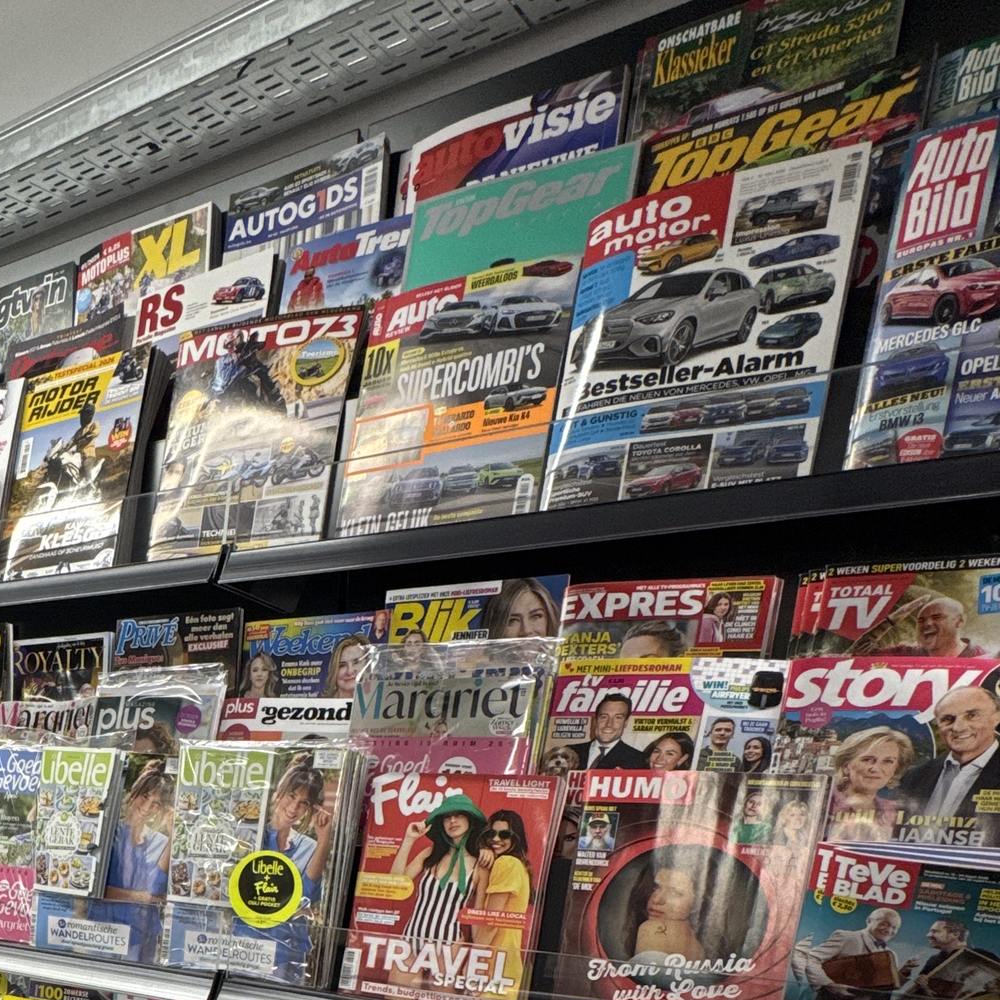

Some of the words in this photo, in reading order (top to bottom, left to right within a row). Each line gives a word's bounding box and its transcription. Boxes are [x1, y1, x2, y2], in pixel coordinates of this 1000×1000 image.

[658, 10, 741, 52] ONSCHATBARE
[780, 24, 841, 50] Strada
[653, 33, 738, 88] Klassieker
[647, 78, 919, 194] TopGear
[906, 129, 996, 192] Auto
[419, 163, 623, 241] TopGear
[902, 174, 983, 243] Bild
[589, 195, 693, 247] auto
[604, 211, 712, 256] motor
[81, 246, 131, 287] MOTOPLUS
[134, 218, 201, 289] XL
[470, 270, 518, 291] WEERGALOOS
[137, 283, 185, 339] RS
[878, 324, 948, 353] MERCEDES
[952, 318, 982, 336] GLC
[397, 342, 545, 400] SUPERCOMBI'S
[28, 376, 99, 410] MOTOR
[837, 565, 869, 575] WEKEN
[871, 559, 955, 573] SUPERVOORDELIG
[830, 586, 893, 597] TOTAAL
[391, 600, 484, 642] Blik
[828, 596, 890, 630] TV
[188, 640, 228, 651] EXCLUSIEF
[452, 629, 488, 642] JENNIFER
[280, 667, 321, 677] ONBEGRIP
[577, 665, 591, 673] MET
[593, 663, 682, 673] MINI-LIEFDESROMAN
[703, 681, 728, 689] WIN!
[786, 659, 984, 724] story
[224, 700, 254, 719] plus
[588, 775, 689, 800] HUMO
[252, 859, 284, 876] Libelle
[834, 856, 909, 889] TeVe
[254, 881, 279, 895] Flair
[833, 879, 906, 905] BLAD
[50, 928, 127, 948] WANDELROUTES
[66, 922, 119, 934] romantische
[362, 936, 514, 989] TRAVEL
[587, 958, 660, 981] From
[665, 953, 755, 980] Russia
[363, 982, 395, 995] Trends,
[433, 973, 508, 995] SPECIAL
